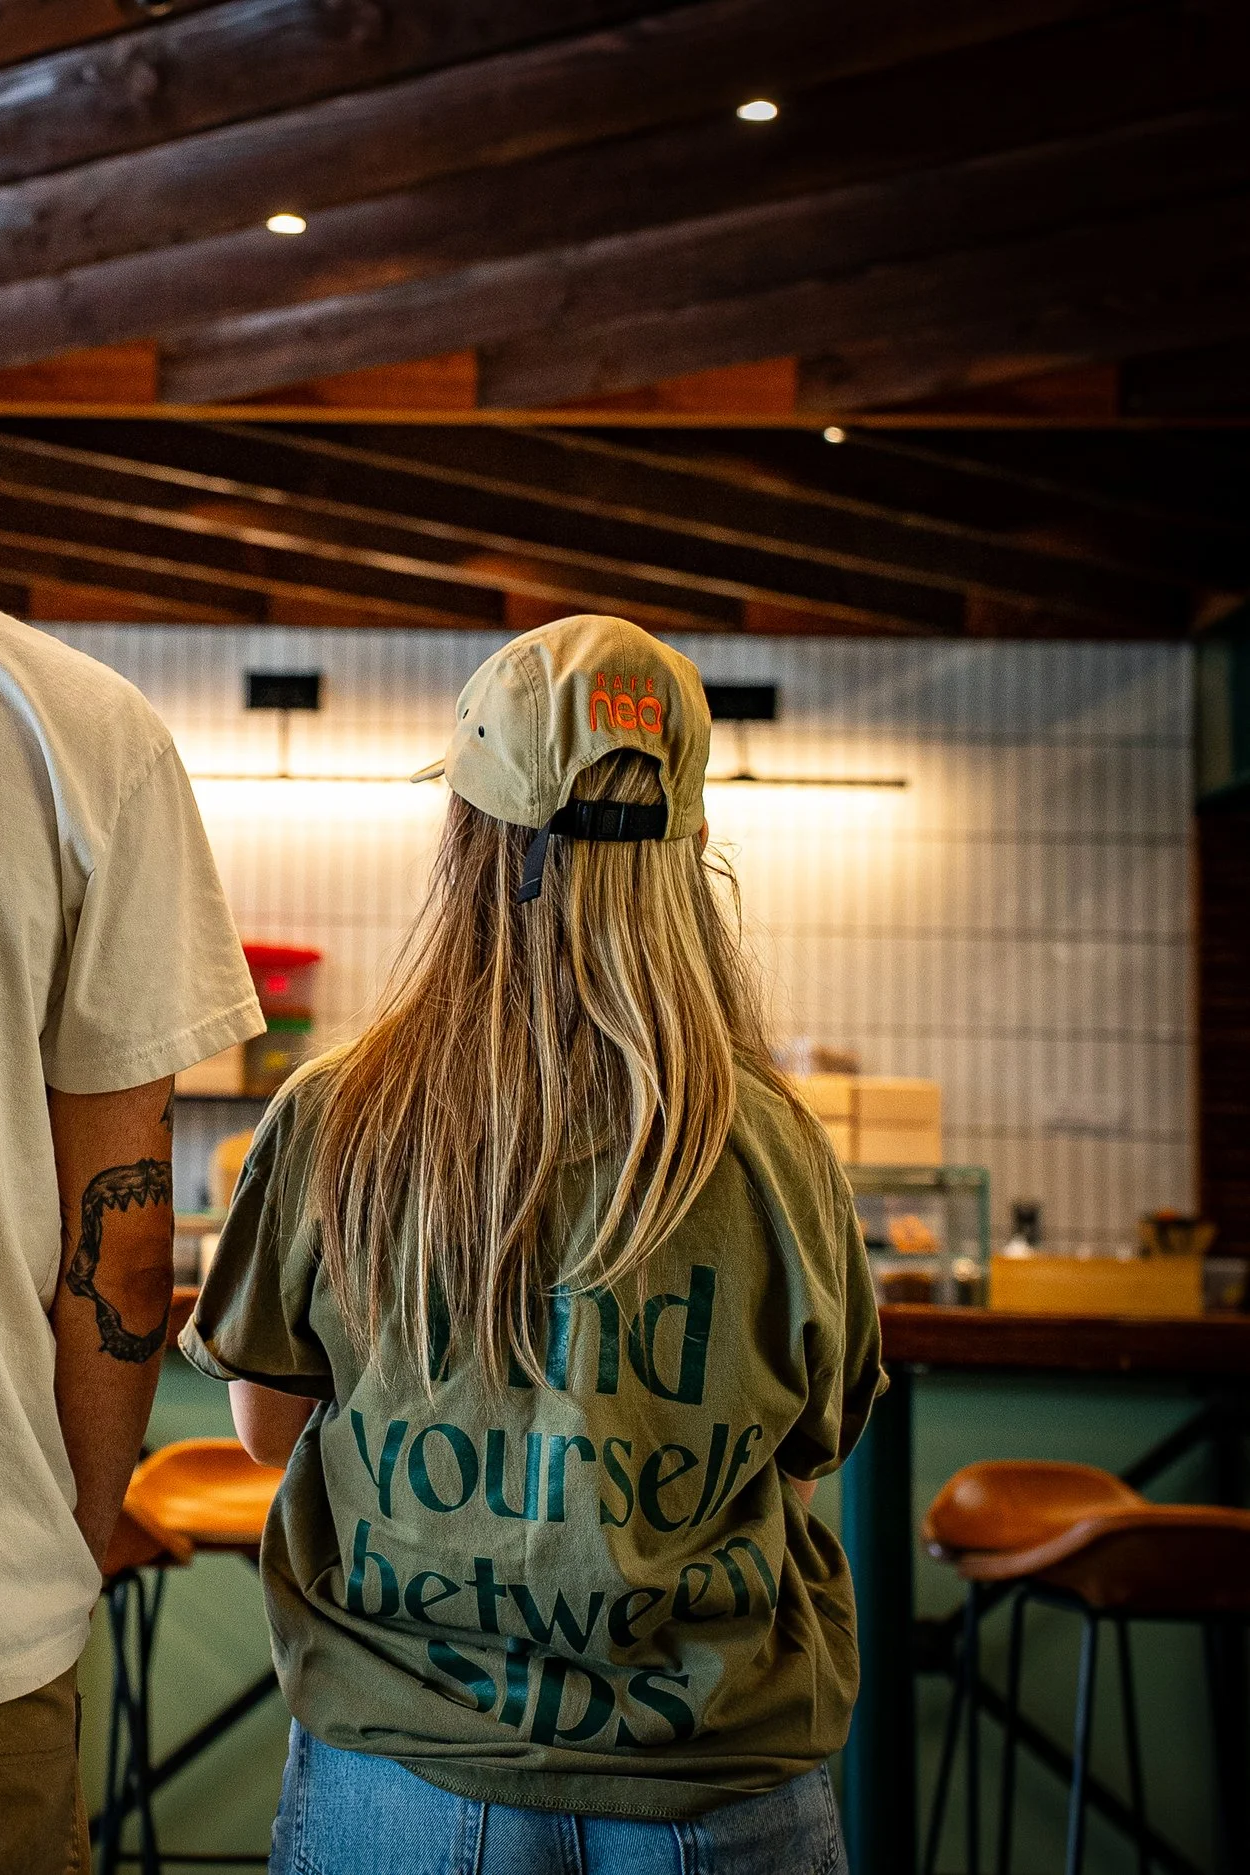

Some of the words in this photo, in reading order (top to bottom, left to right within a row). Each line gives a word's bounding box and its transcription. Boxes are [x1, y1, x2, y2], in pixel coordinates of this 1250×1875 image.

[590, 689, 662, 734] neo
[596, 672, 655, 693] KAFE
[426, 1264, 717, 1405] nd
[350, 1408, 763, 1533] yourself
[347, 1519, 778, 1655] between
